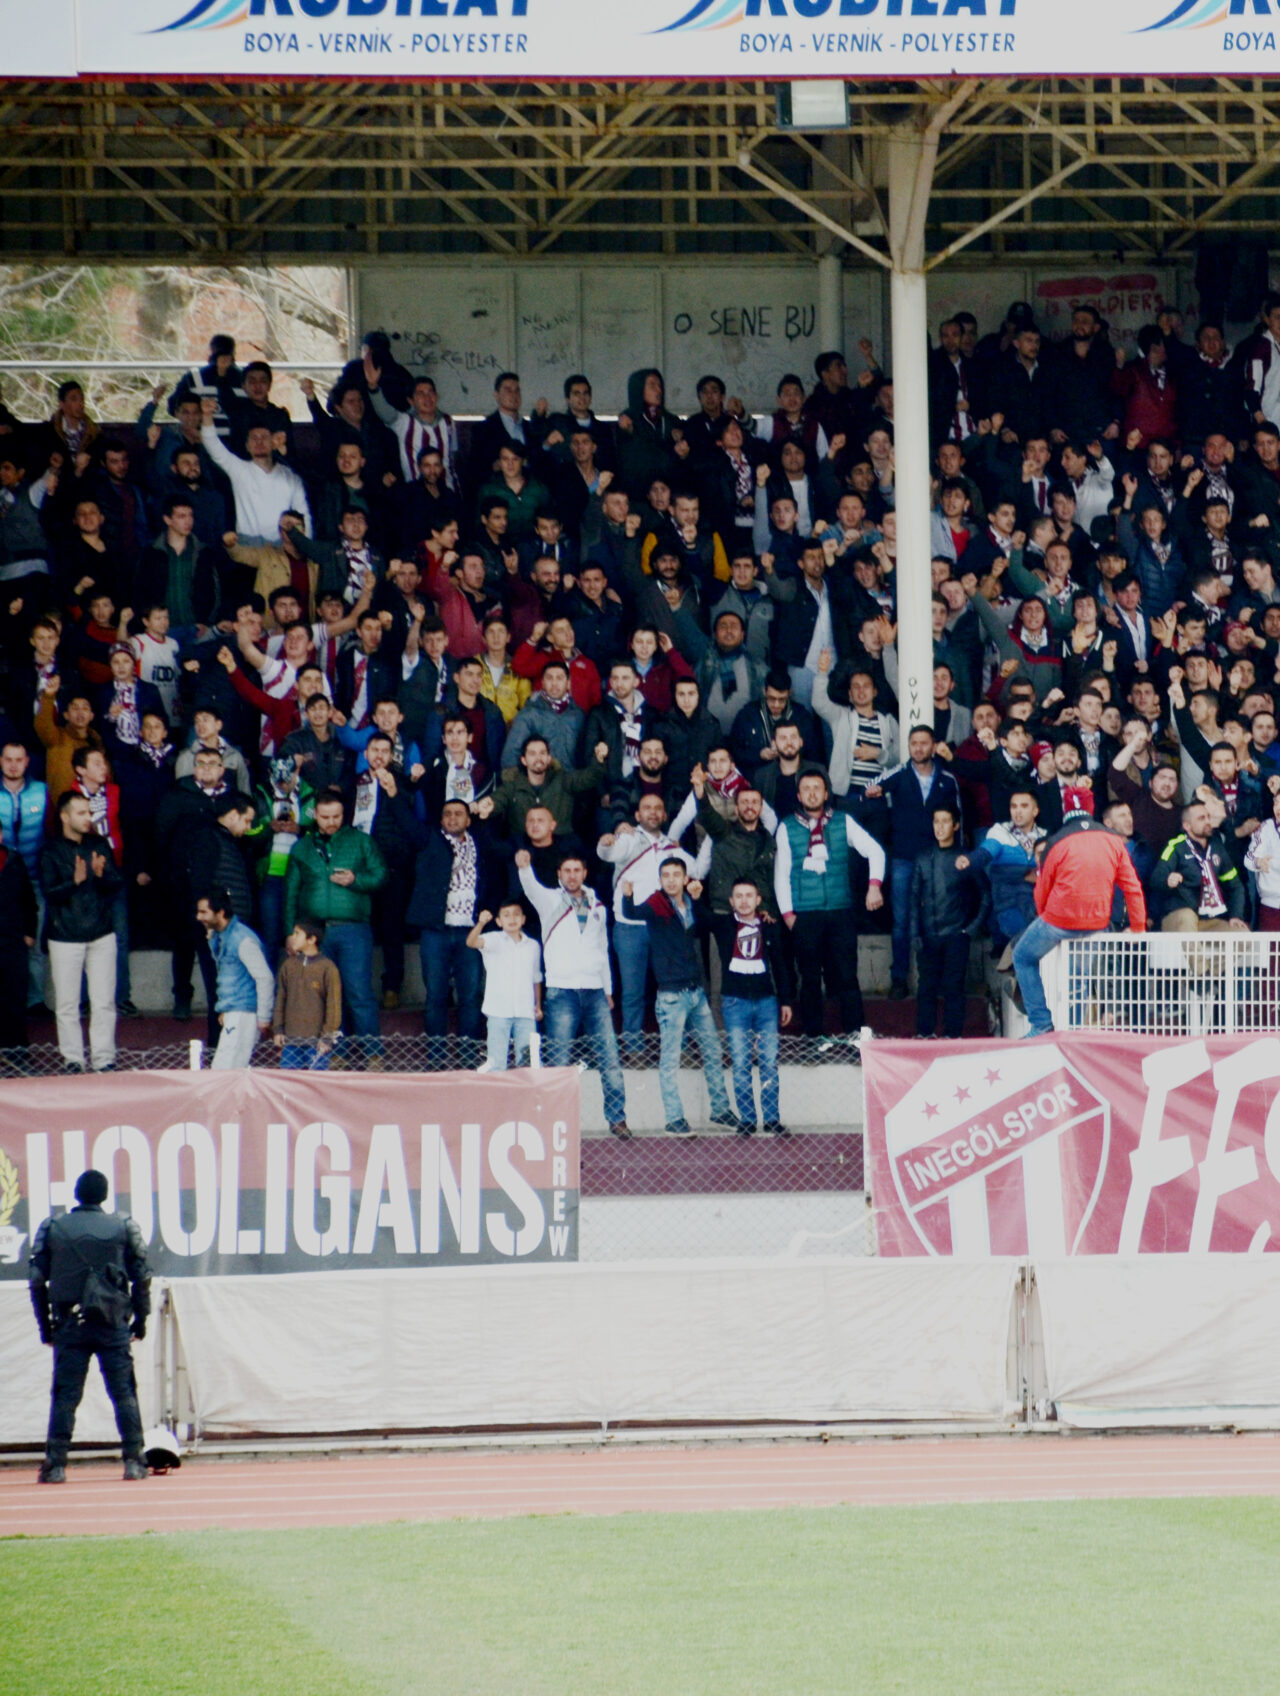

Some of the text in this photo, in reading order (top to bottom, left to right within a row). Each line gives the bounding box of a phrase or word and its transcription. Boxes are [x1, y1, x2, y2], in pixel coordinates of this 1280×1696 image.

[244, 33, 300, 53] BOYA
[319, 27, 393, 53] VERNİK
[411, 33, 528, 53] POLYESTER
[739, 33, 793, 52] BOYA
[812, 26, 883, 52] VERNİK
[901, 32, 1015, 52] POLYESTER
[1223, 31, 1276, 50] BOYA
[674, 304, 816, 341] O SENE BU
[907, 676, 921, 727] OYN
[906, 1083, 1078, 1192] İNEGÖLSPOR
[26, 1121, 545, 1257] HOOLIGANS
[549, 1120, 570, 1257] CREW
